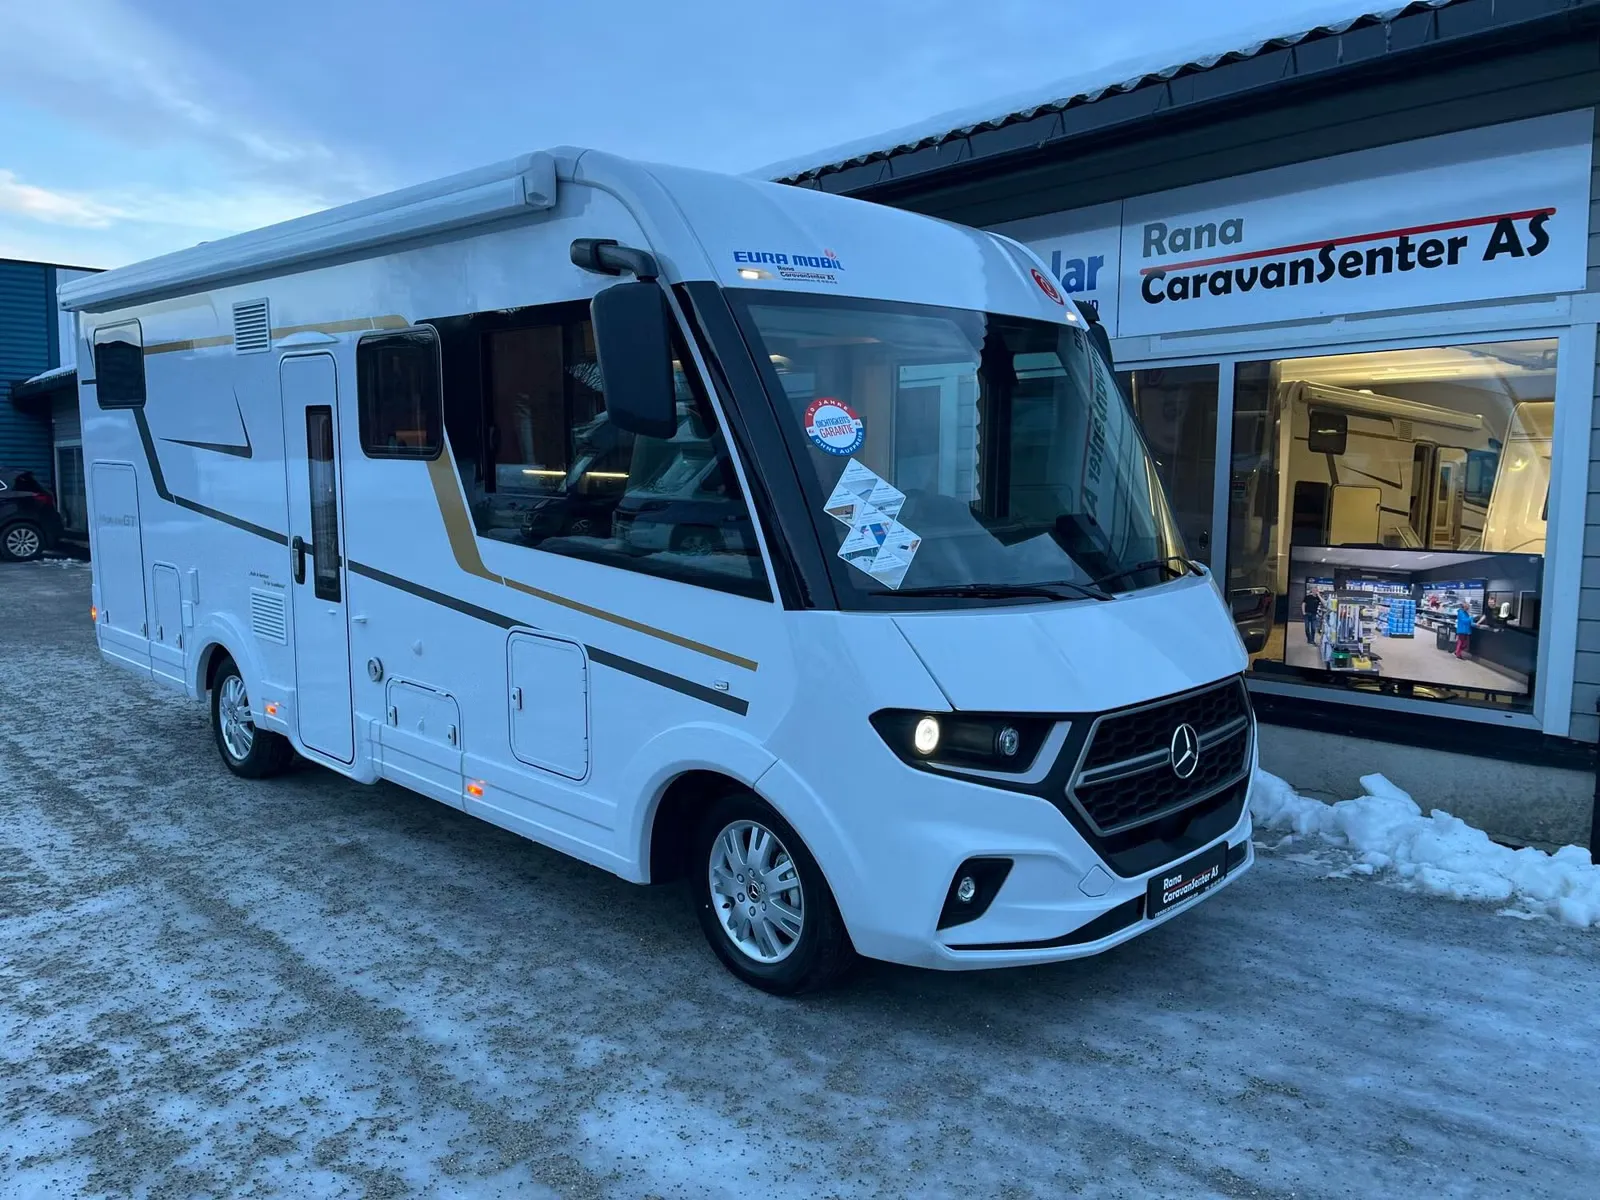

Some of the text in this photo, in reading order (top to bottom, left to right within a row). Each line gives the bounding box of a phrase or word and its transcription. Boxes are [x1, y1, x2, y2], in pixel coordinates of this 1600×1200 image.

[1141, 211, 1551, 304] CaravanSenter AS
[1143, 218, 1244, 258] Rana
[733, 251, 845, 271] EURA MOBIL
[1051, 250, 1104, 293] lar
[820, 424, 855, 439] GARANTIE
[1162, 873, 1210, 904] CaravanSenter
[1210, 864, 1219, 879] AS
[1163, 874, 1182, 891] Rana
